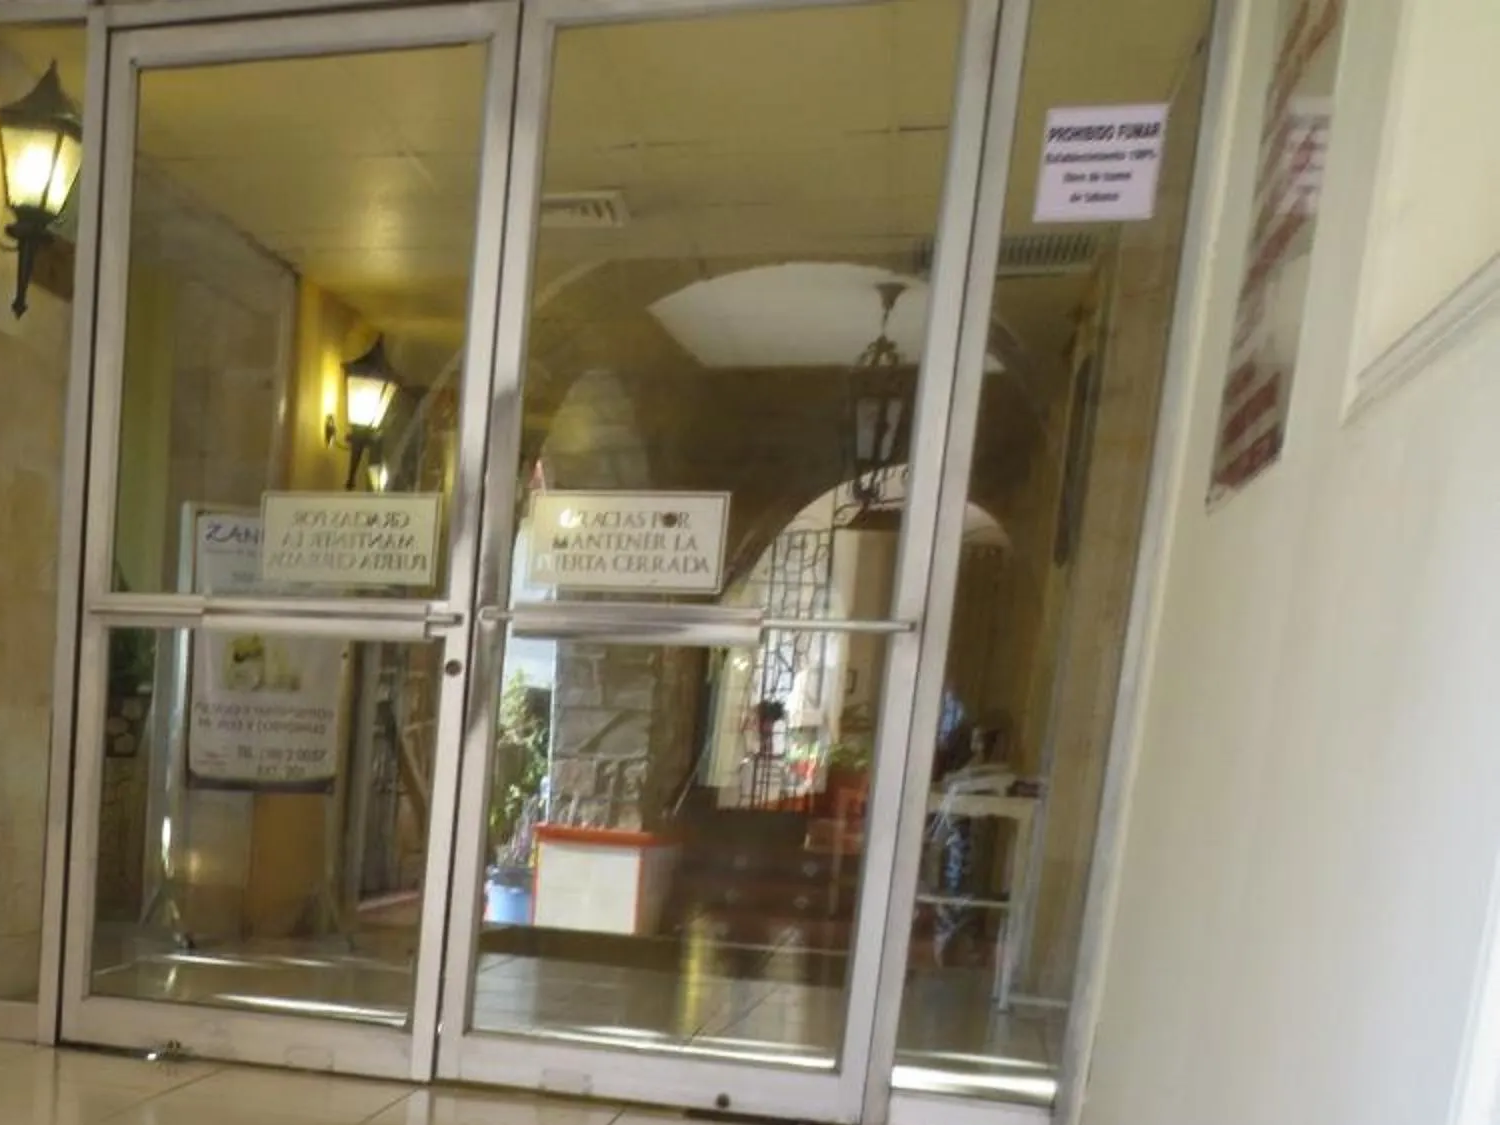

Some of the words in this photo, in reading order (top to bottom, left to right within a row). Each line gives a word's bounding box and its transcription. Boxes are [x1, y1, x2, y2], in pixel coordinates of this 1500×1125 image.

[1047, 125, 1114, 143] PROHIBIDO
[1117, 121, 1161, 141] FUMAR
[560, 509, 647, 530] RACIAS
[650, 510, 691, 530] PR
[552, 531, 667, 552] MANTENER
[673, 532, 699, 552] LA
[611, 552, 710, 575] CERRADA
